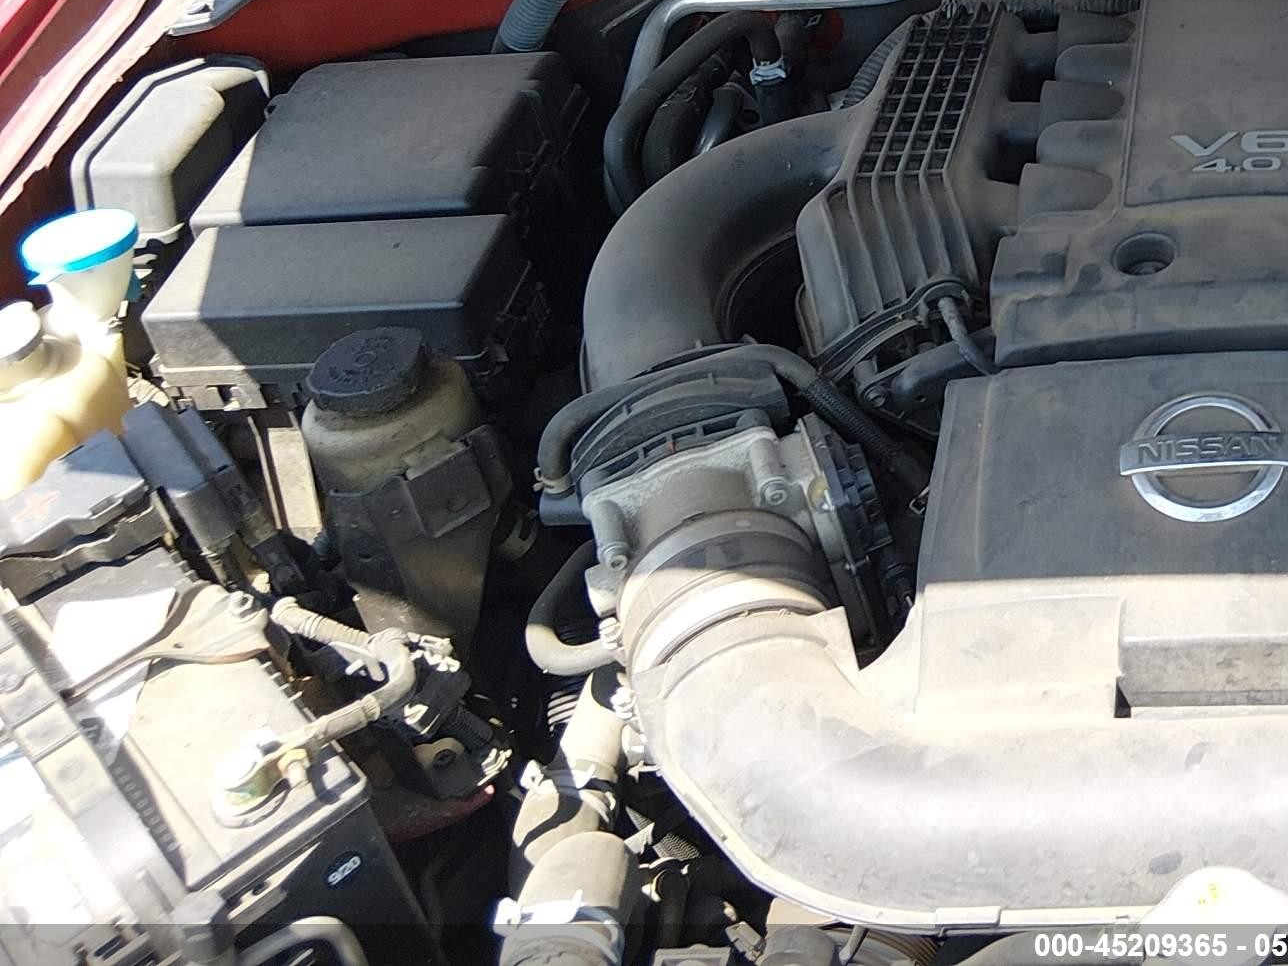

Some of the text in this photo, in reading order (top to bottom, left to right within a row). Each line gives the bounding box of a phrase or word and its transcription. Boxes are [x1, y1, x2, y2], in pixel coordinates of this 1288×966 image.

[1191, 156, 1282, 173] 4.0
[1138, 436, 1281, 465] NISSAN
[327, 855, 362, 886] 9/20
